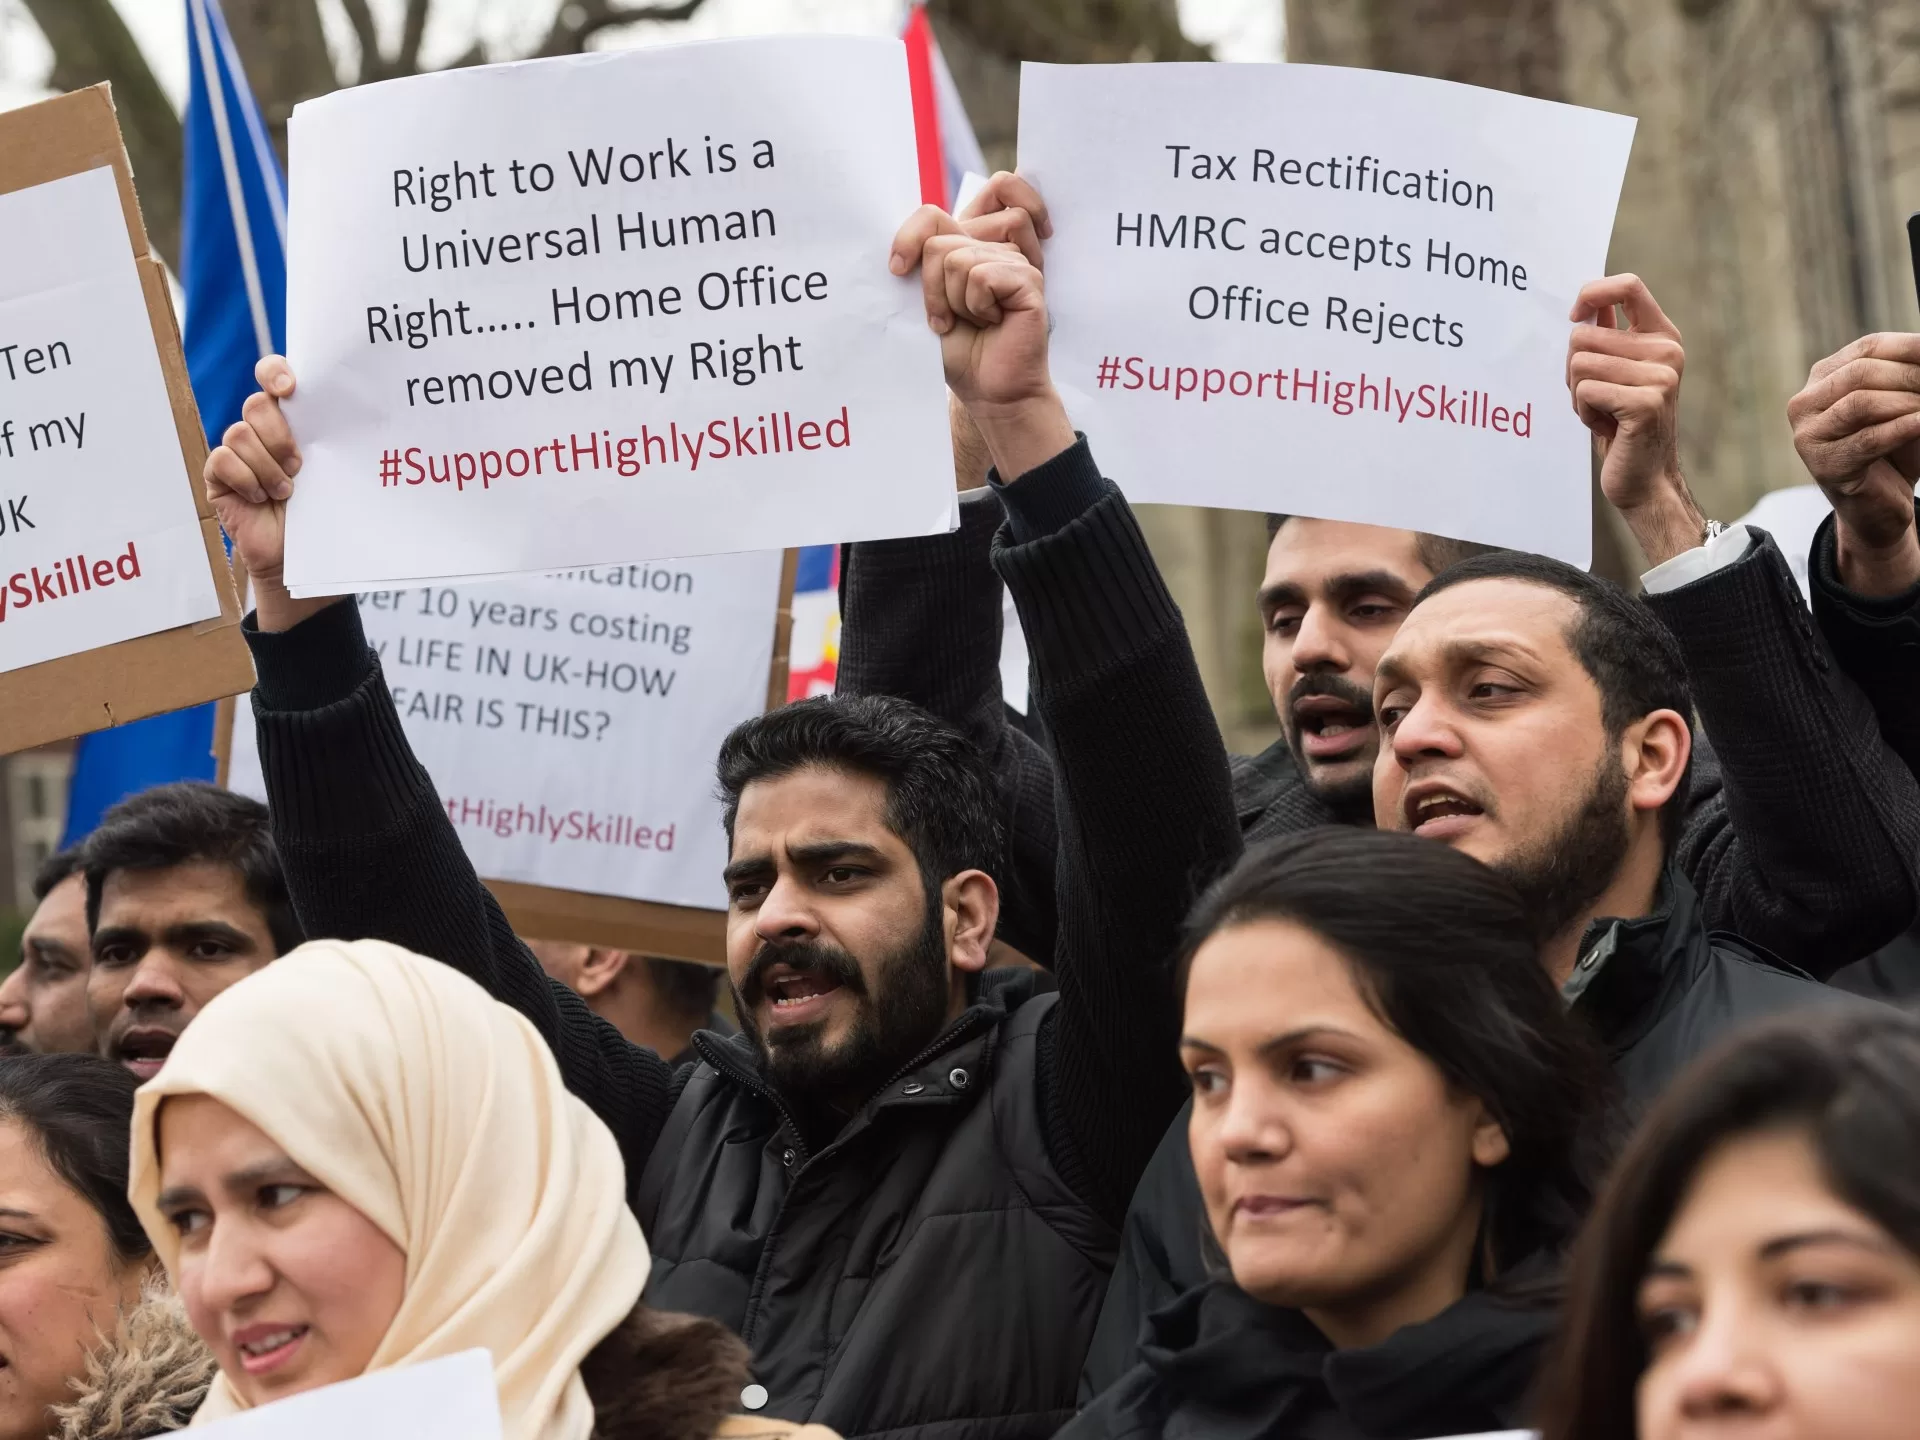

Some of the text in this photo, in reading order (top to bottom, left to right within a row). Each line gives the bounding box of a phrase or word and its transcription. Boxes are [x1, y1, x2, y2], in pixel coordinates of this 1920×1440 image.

[393, 135, 775, 213] Right to Work is a
[1164, 144, 1494, 212] Tax Rectification
[402, 208, 776, 273] Universal Human
[1116, 212, 1528, 291] HMRC accepts Home
[551, 286, 682, 326] Home
[697, 264, 828, 311] Office
[1188, 284, 1464, 348] Office Rejects
[0, 341, 72, 381] Ten
[406, 333, 804, 407] removed my Right
[1096, 355, 1532, 439] #SupportHighlySkilled
[0, 412, 85, 458] f my
[379, 405, 851, 492] #SupportHighlySkilled
[0, 495, 36, 537] K
[355, 586, 693, 656] ver 10 years costing
[397, 635, 465, 672] LIFE
[475, 644, 511, 678] IN
[391, 687, 612, 742] FAIR IS THIS?
[437, 795, 677, 853] tHighlySkilled
